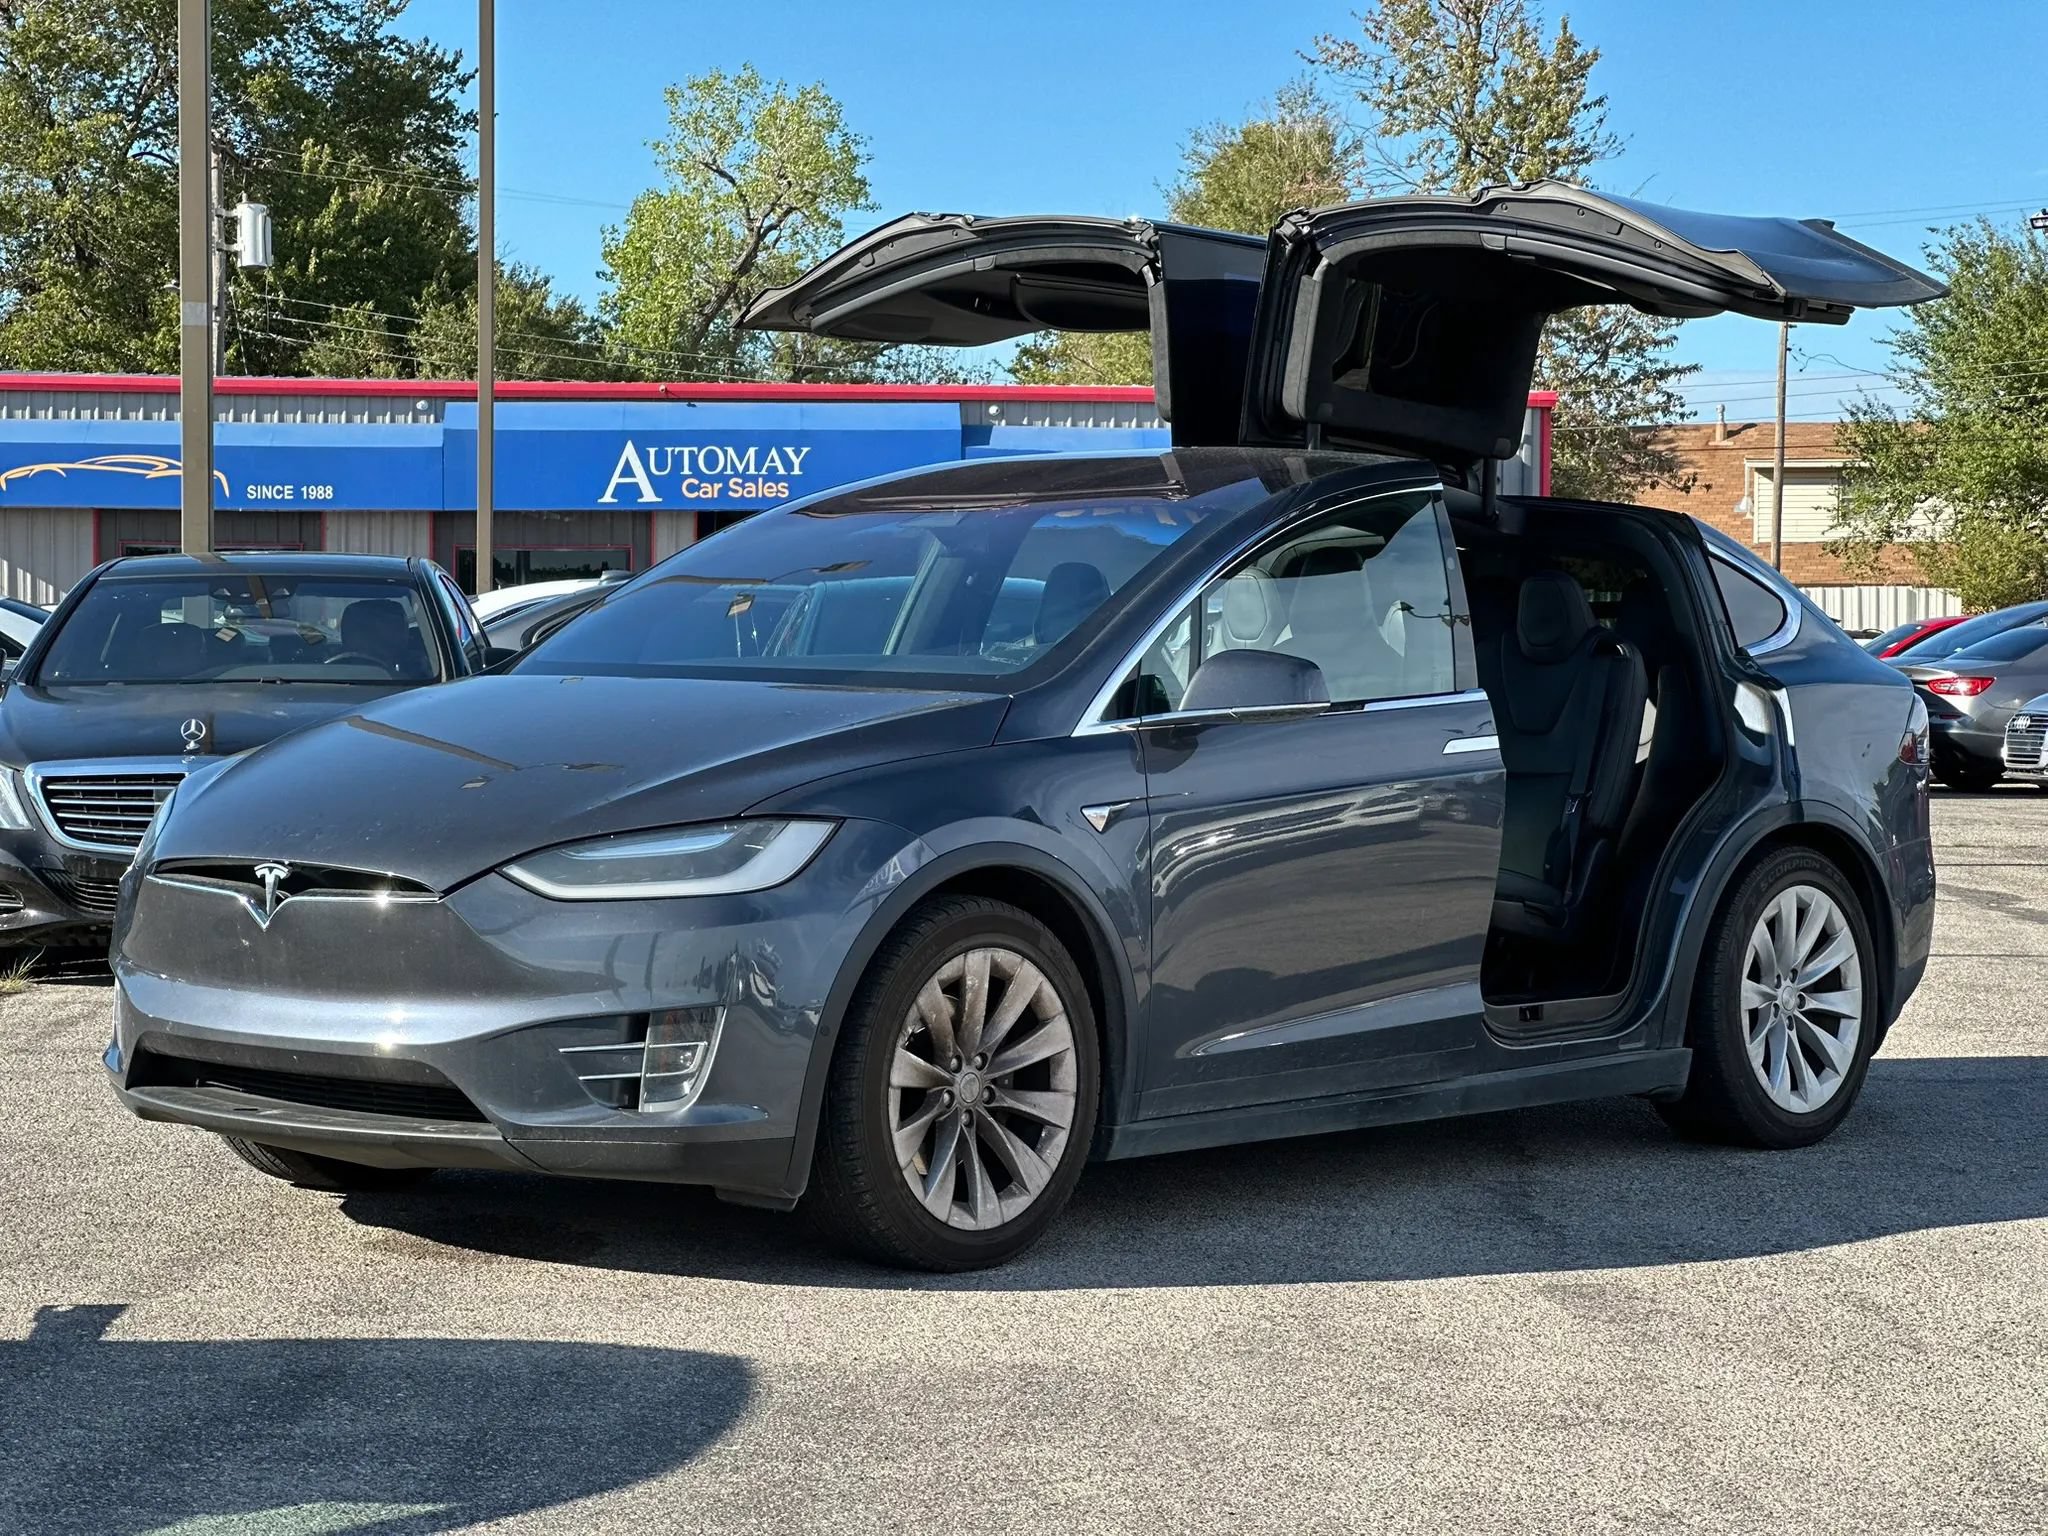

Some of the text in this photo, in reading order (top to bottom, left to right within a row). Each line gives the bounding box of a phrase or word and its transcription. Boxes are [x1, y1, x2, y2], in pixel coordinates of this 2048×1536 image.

[597, 439, 811, 503] AUTOMAY
[246, 484, 334, 500] SINCE 1988
[681, 477, 790, 499] Car Sales
